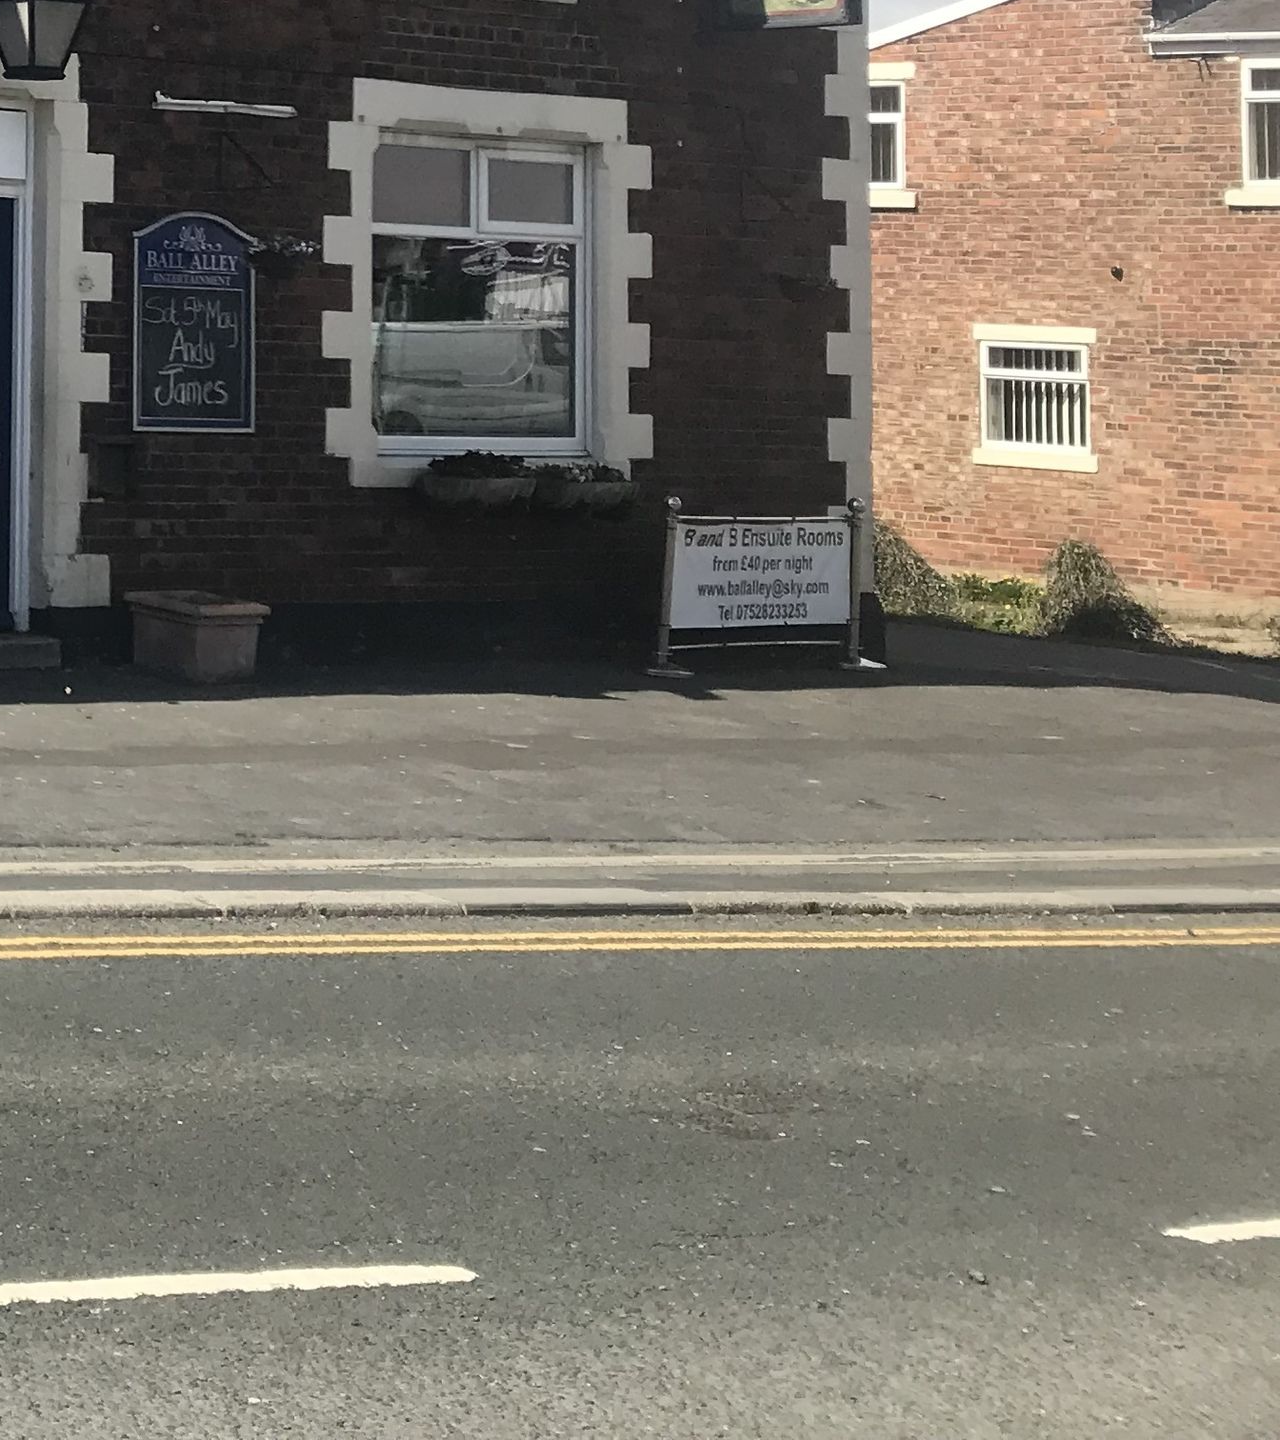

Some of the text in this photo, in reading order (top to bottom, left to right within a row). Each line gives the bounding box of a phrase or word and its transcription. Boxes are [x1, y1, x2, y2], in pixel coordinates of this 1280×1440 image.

[146, 251, 238, 272] BALL ALLEY
[153, 272, 232, 286] ENTERTAINMENT
[205, 300, 239, 348] May
[164, 328, 216, 369] Andy
[155, 367, 228, 407] James
[684, 527, 843, 547] B and B Ensuite Rooms
[713, 555, 813, 575] from £40 per night
[698, 579, 829, 598] www.ballalley@sky.com
[718, 604, 733, 620] Tel
